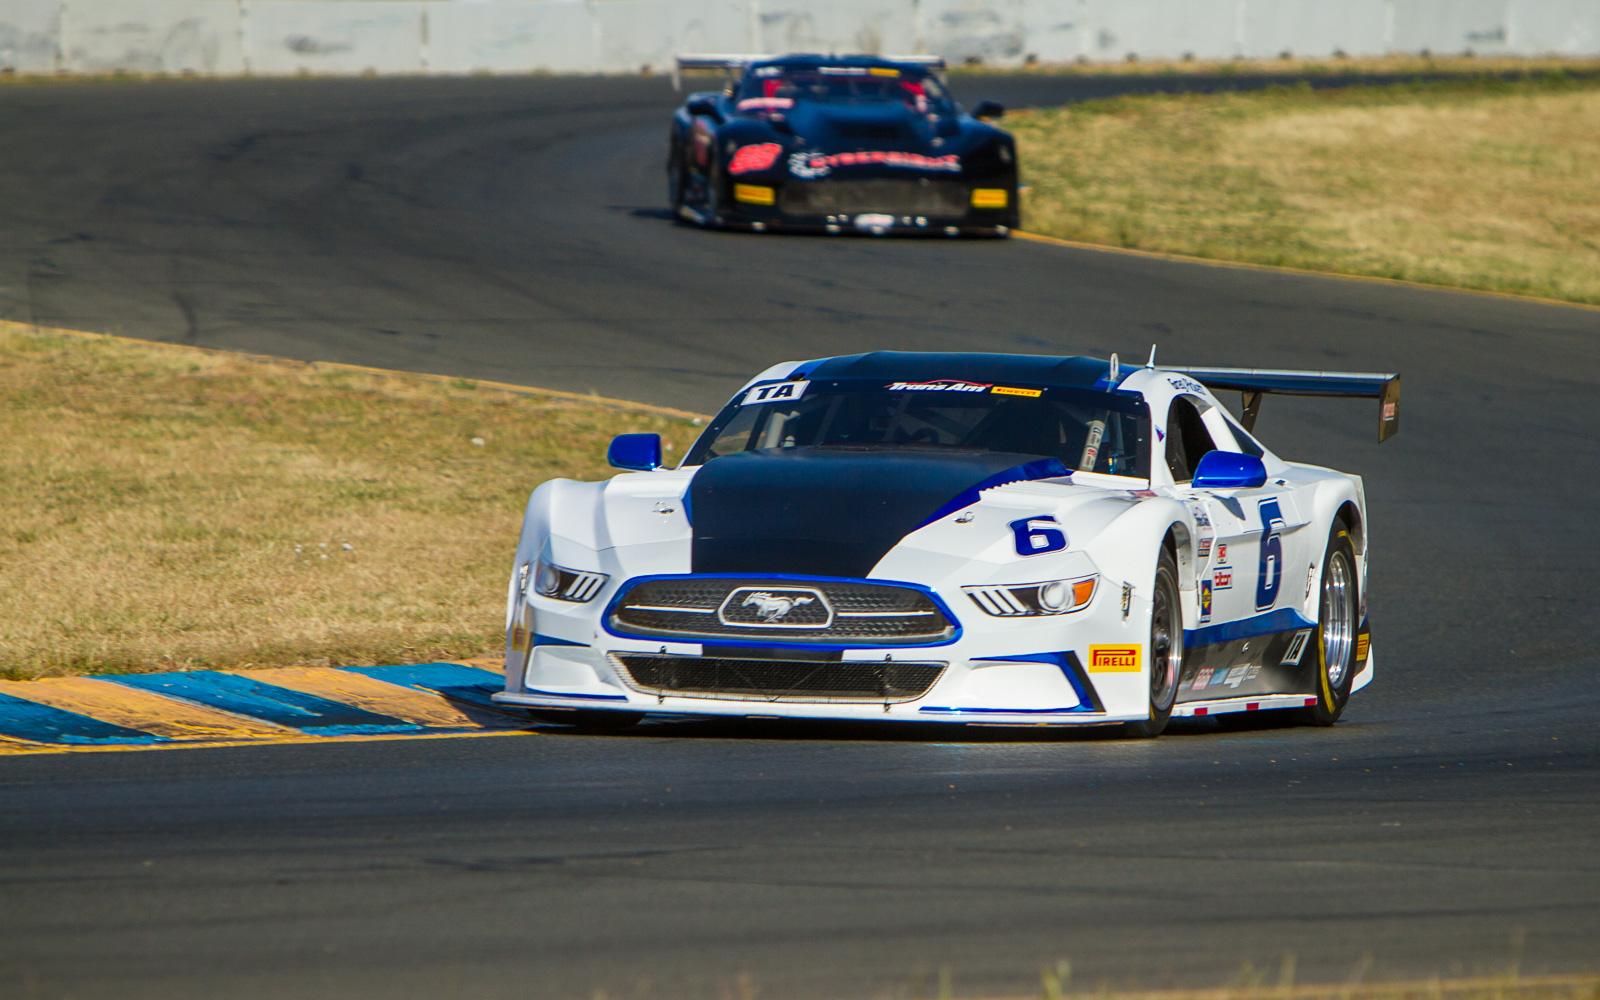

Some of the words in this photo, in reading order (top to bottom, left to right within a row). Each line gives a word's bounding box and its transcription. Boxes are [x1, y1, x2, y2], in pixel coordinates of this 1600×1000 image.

[757, 384, 795, 401] TA
[888, 382, 947, 391] Trans
[945, 383, 987, 393] Am
[1008, 515, 1068, 557] 6
[1254, 496, 1285, 613] 6
[1092, 649, 1137, 667] PIRELLI
